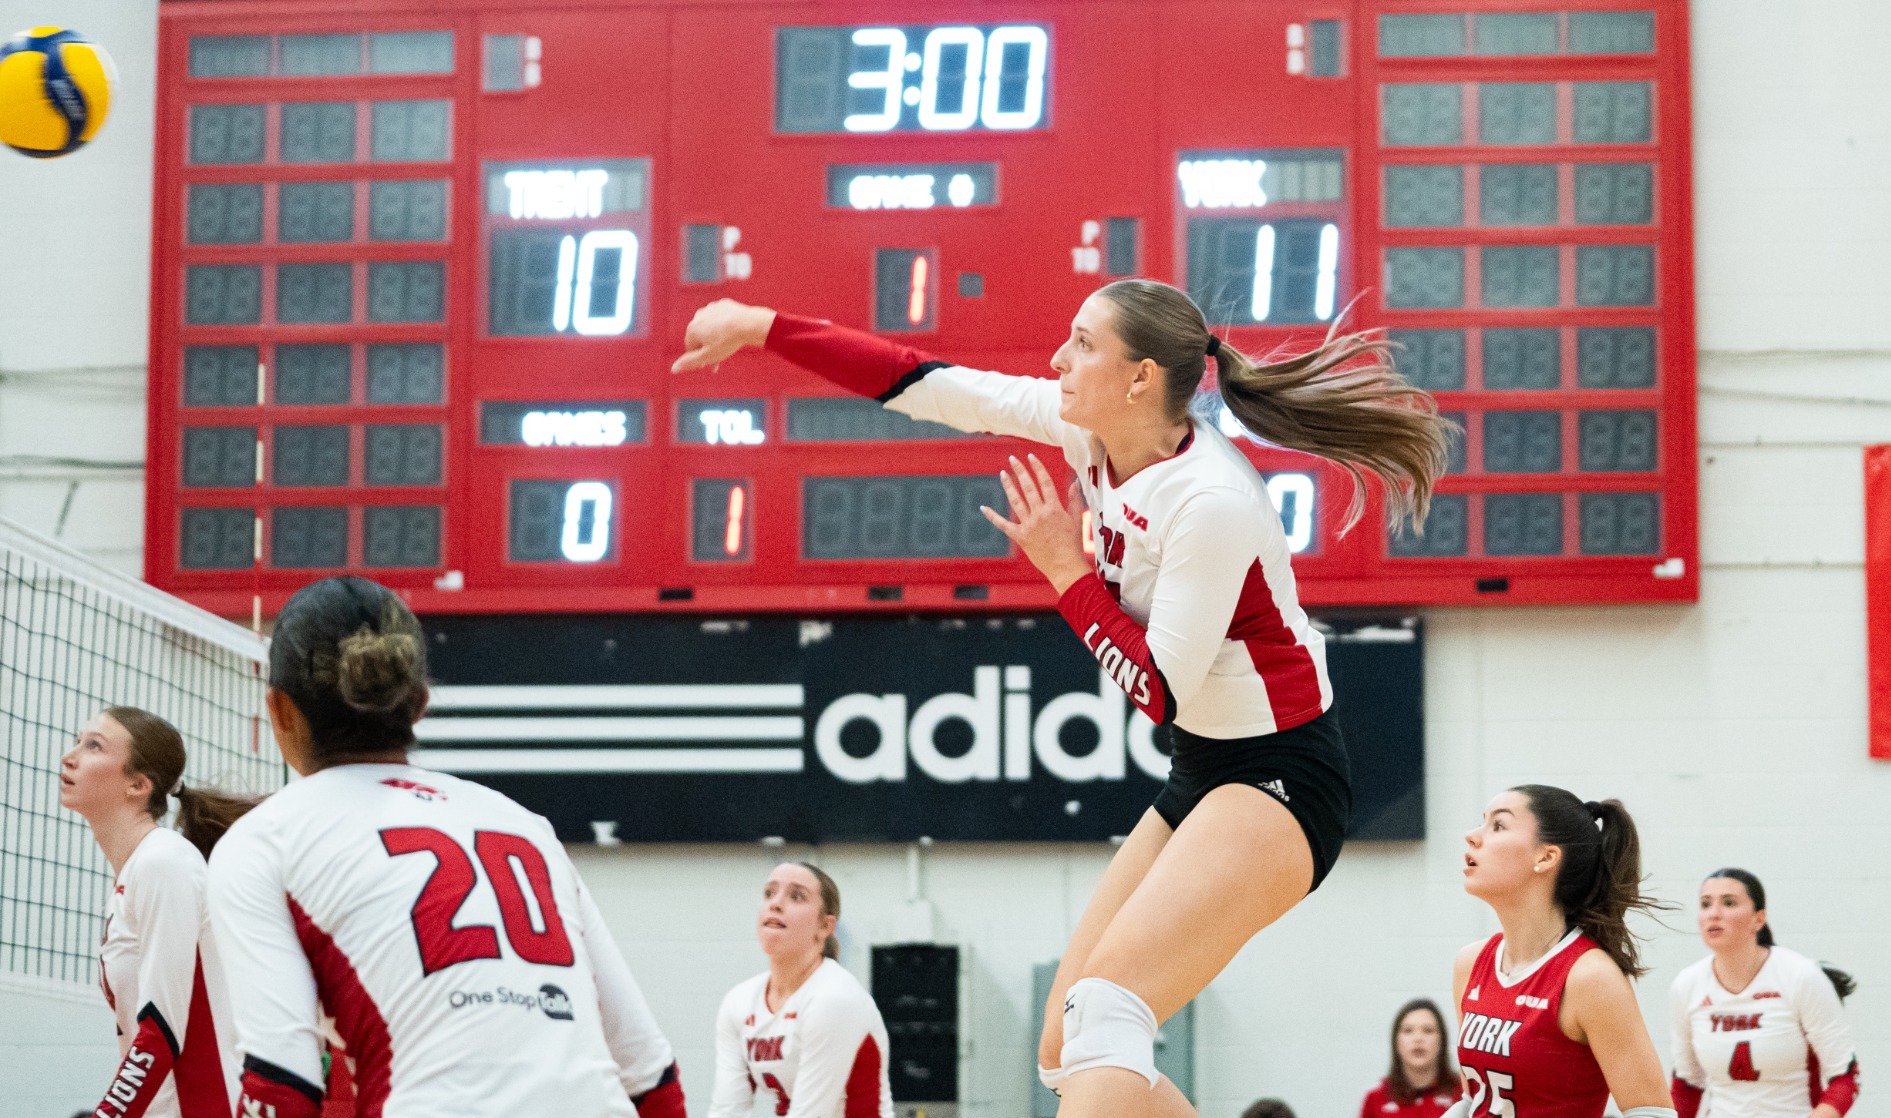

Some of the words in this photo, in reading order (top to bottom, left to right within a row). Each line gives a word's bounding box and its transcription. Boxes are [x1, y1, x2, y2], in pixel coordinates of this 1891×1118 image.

[844, 26, 1048, 132] 3:00
[1178, 160, 1267, 207] YORK
[555, 230, 638, 335] 10
[908, 255, 929, 325] 1
[1252, 224, 1339, 321] 11
[522, 411, 627, 446] GAMES
[562, 482, 613, 561] 0
[725, 486, 745, 556] 1
[1267, 473, 1315, 553] 0
[1083, 622, 1151, 706] LIONS
[814, 665, 1172, 783] adid
[379, 826, 575, 977] 20
[449, 990, 493, 1008] One
[1457, 1011, 1523, 1057] YORK
[1515, 995, 1549, 1010] OUA
[1710, 1012, 1764, 1033] YORK
[1728, 1040, 1761, 1082] 4
